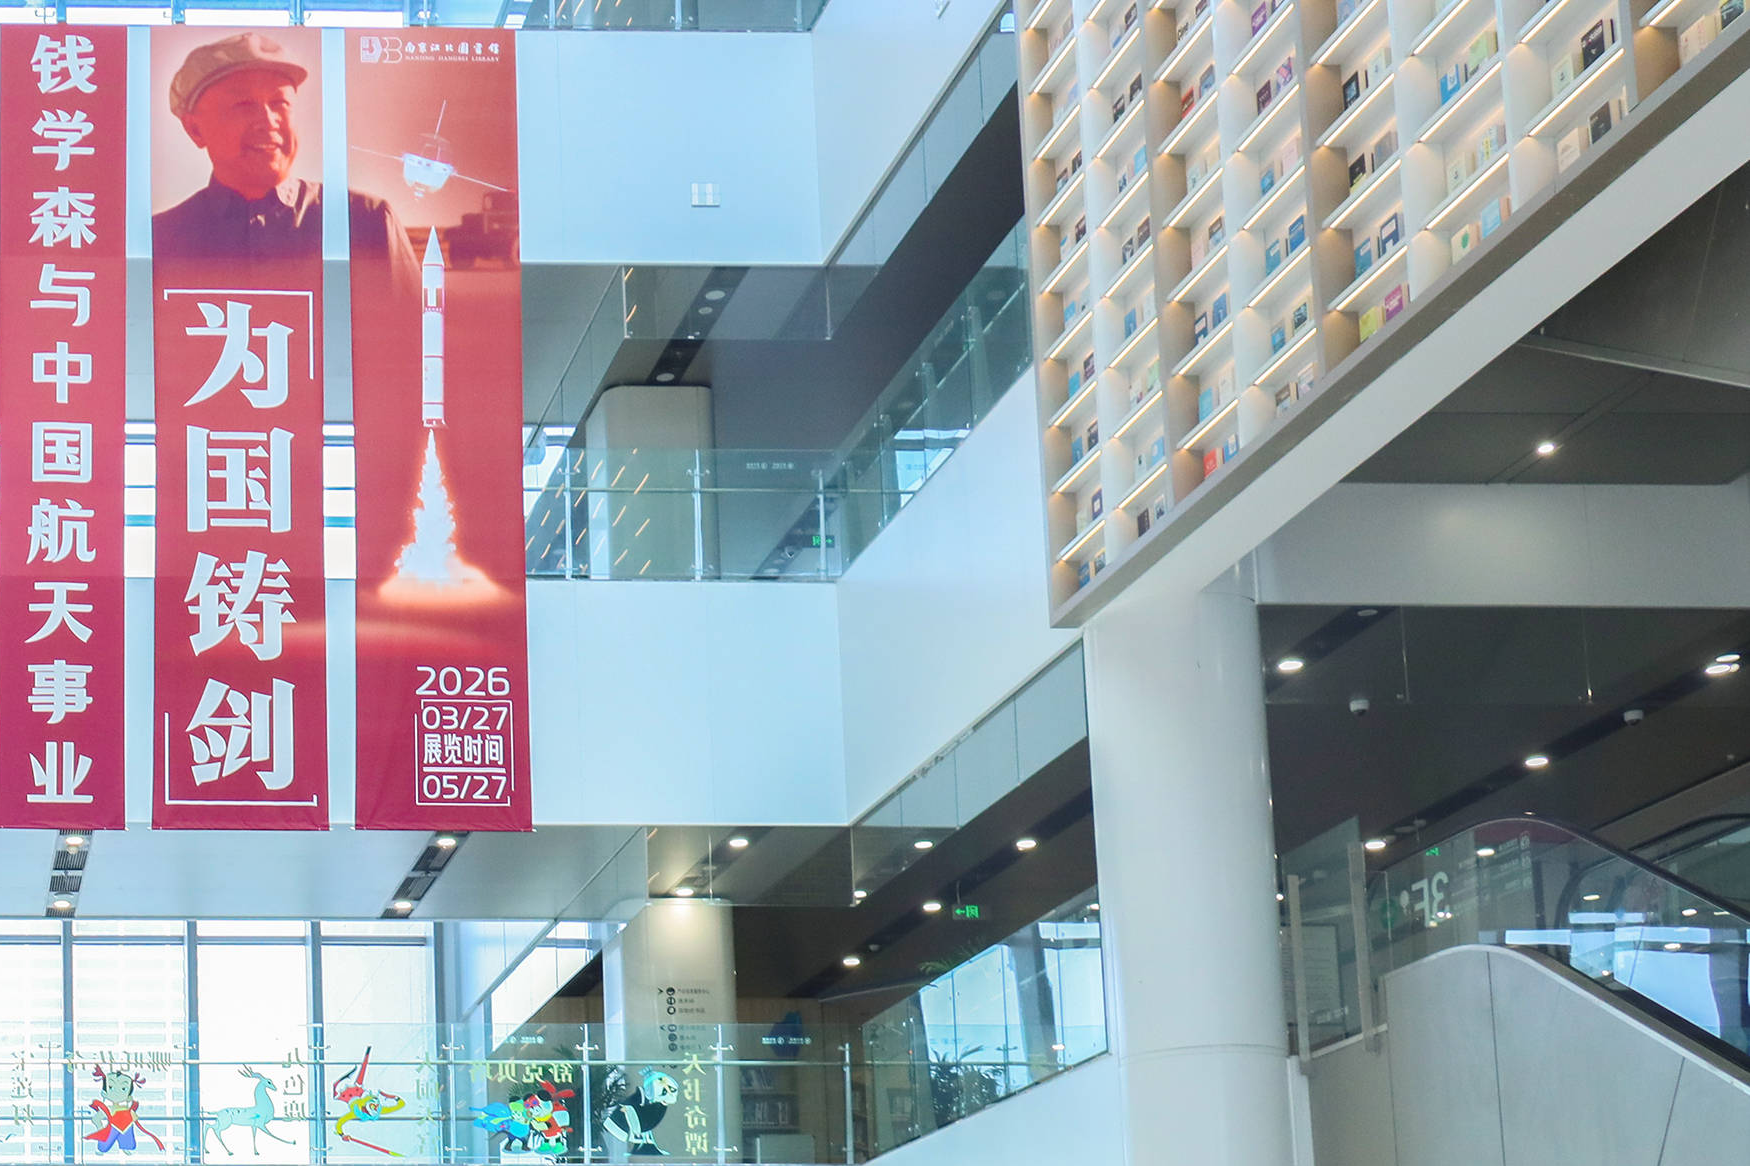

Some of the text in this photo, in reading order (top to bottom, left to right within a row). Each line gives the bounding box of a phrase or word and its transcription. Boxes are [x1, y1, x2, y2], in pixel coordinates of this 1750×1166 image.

[25, 34, 97, 804] 钱学森与中国航天事业
[183, 300, 296, 790] 为国铸剑
[416, 665, 511, 697] 2026
[421, 706, 508, 732] 03/27
[422, 733, 504, 766] 展览时间
[421, 774, 508, 800] 05/27
